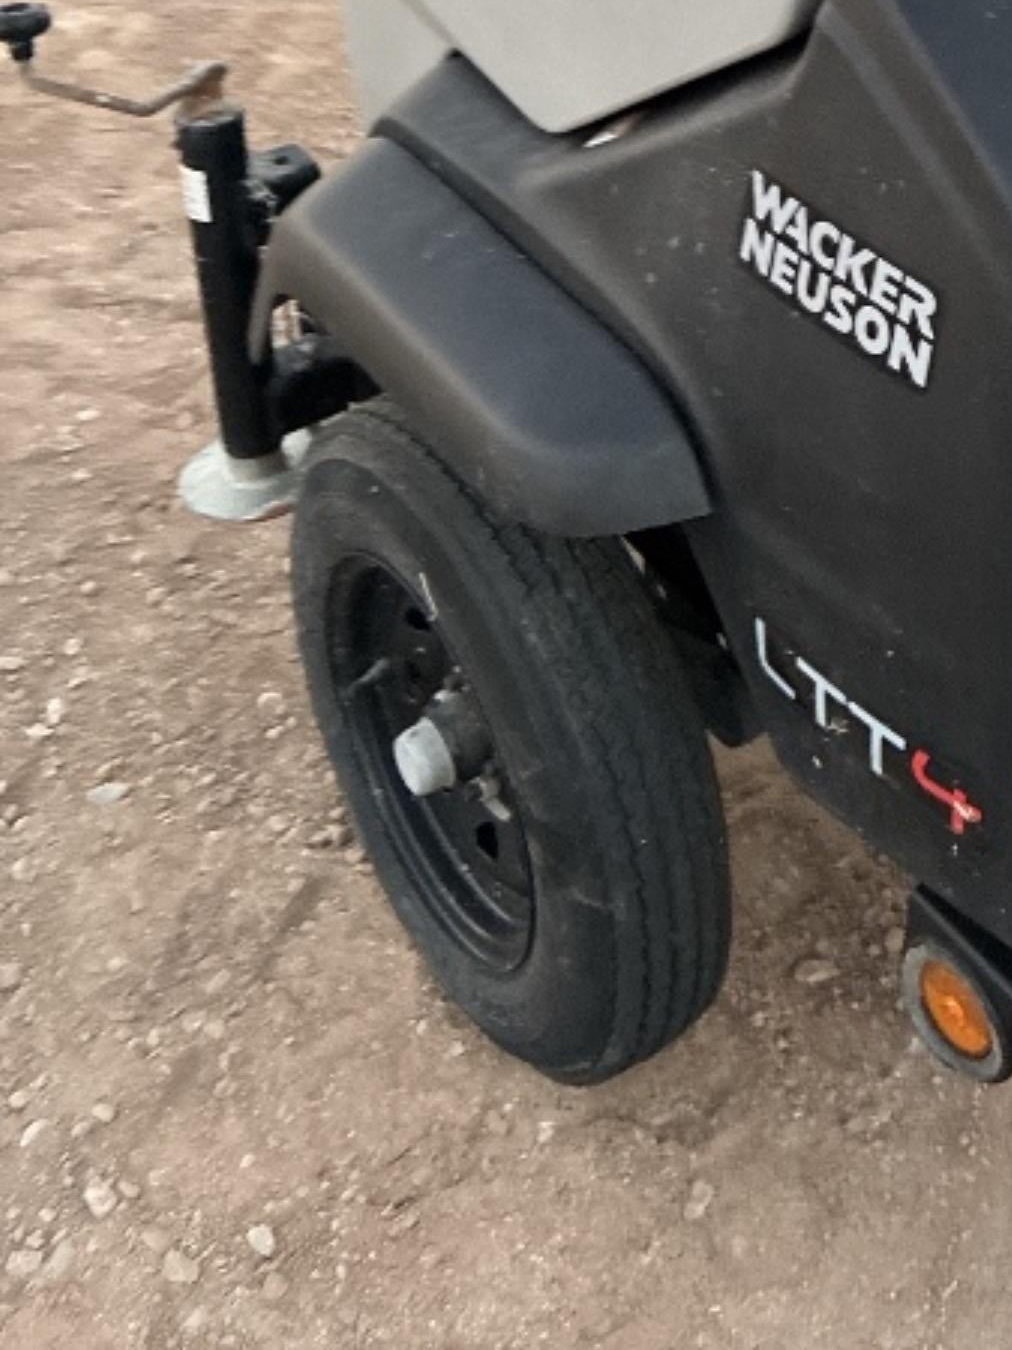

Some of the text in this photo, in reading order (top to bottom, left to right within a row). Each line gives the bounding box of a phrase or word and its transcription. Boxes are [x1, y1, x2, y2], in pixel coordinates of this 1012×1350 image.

[740, 217, 934, 389] NEUSON
[752, 169, 938, 341] WACKER
[754, 617, 982, 836] LTT4
